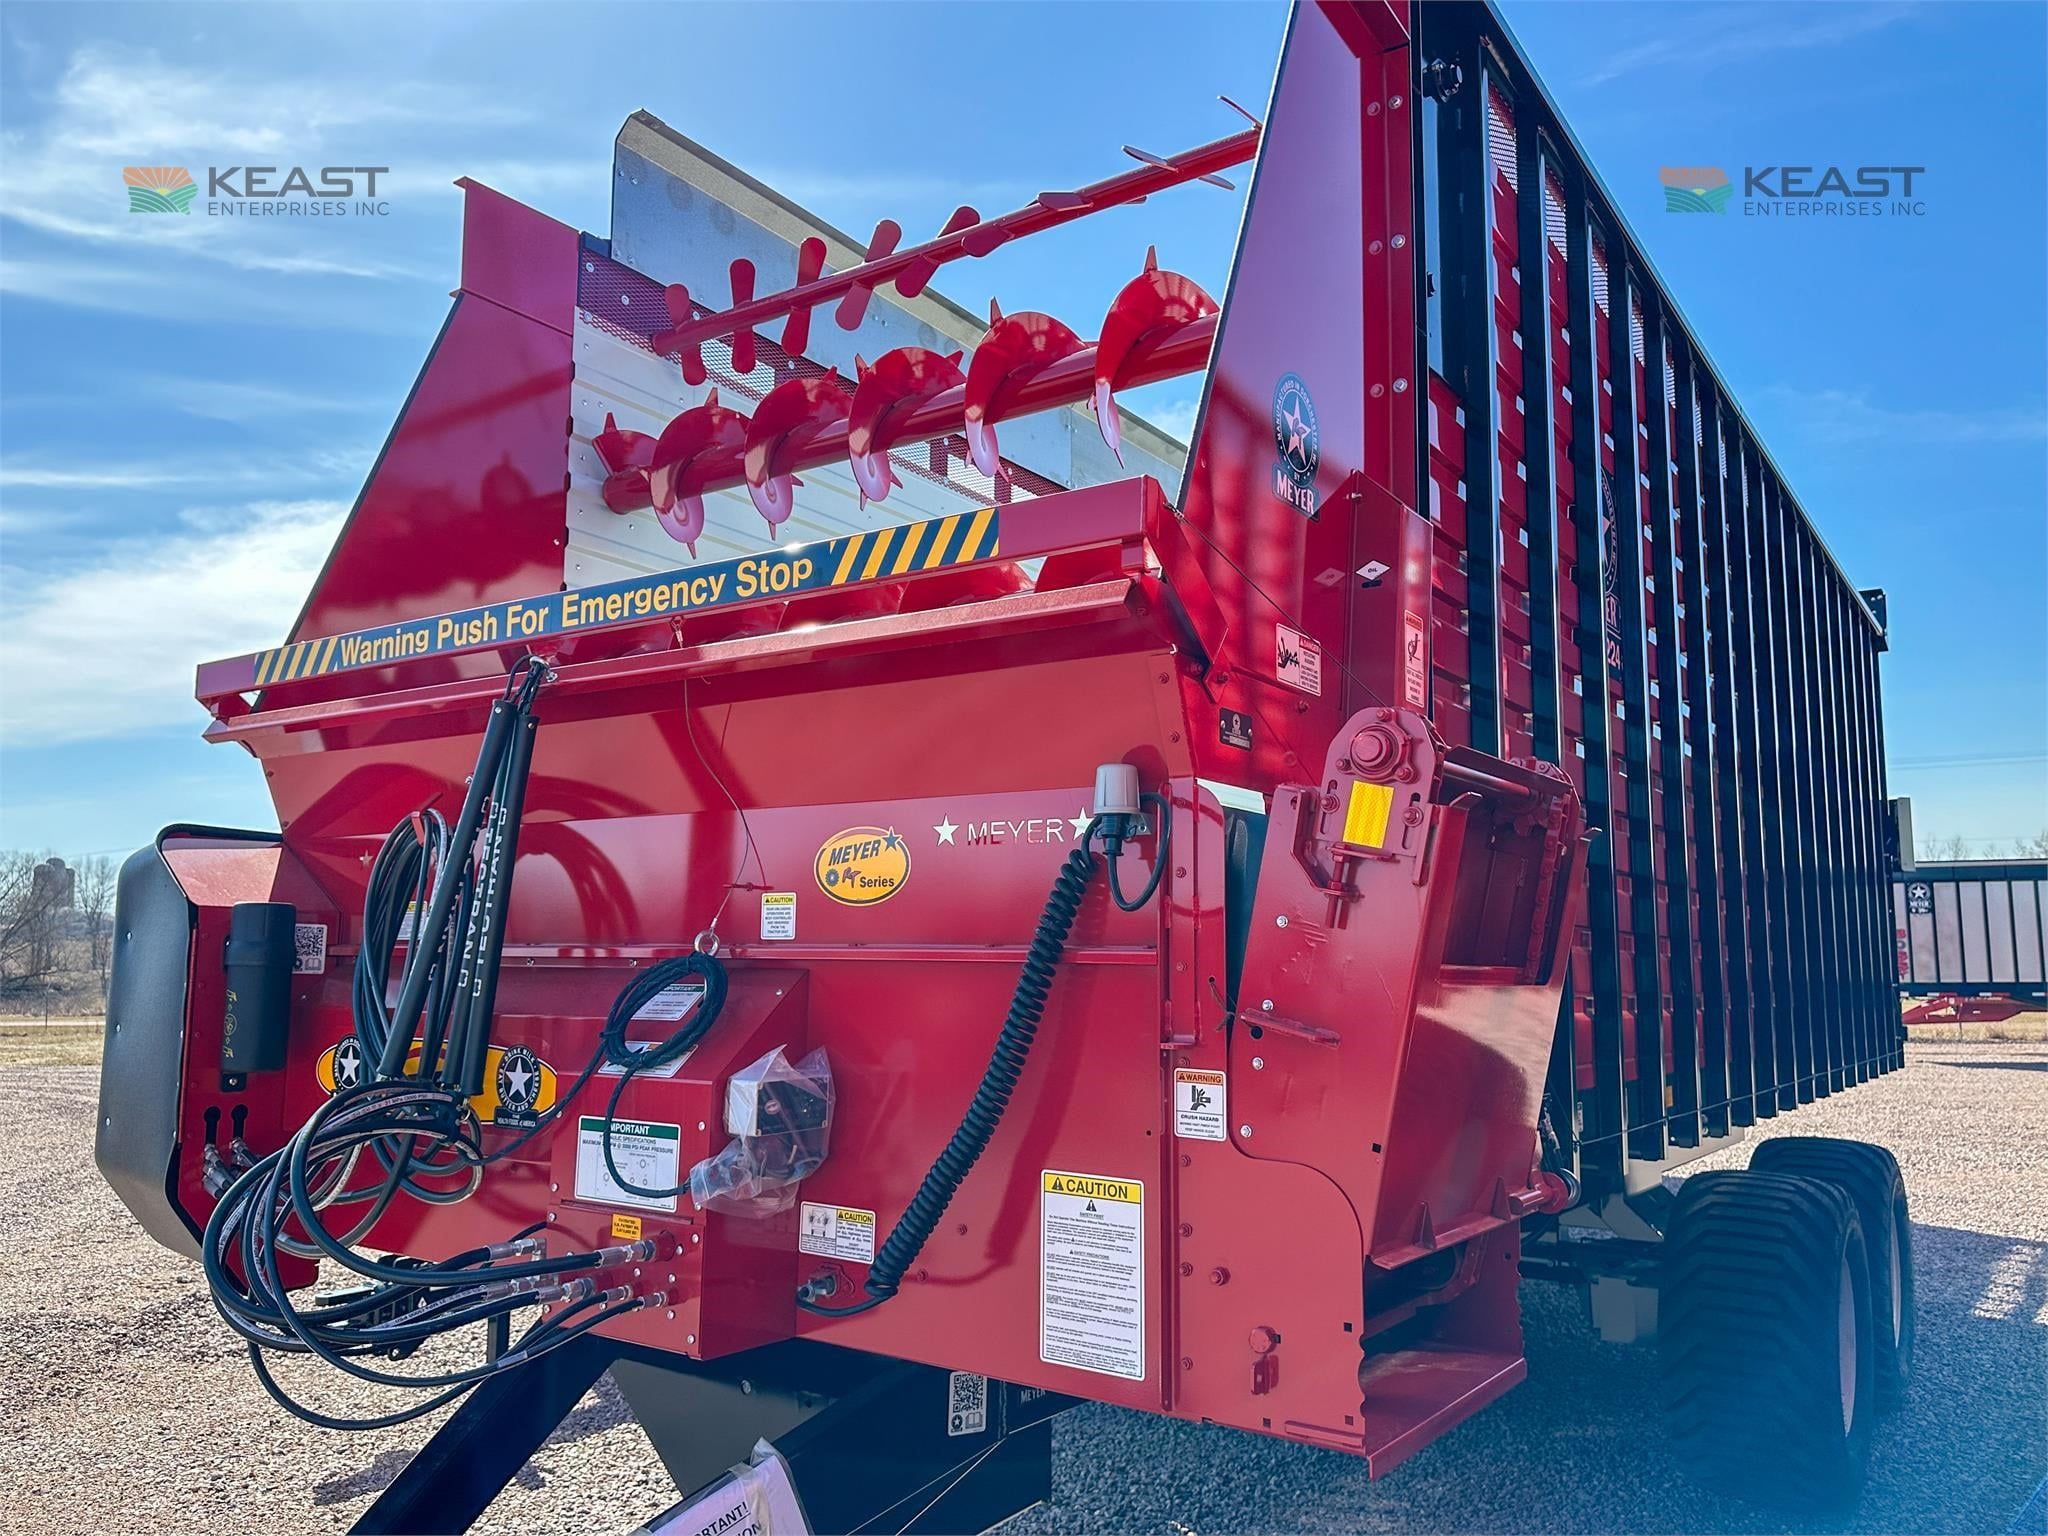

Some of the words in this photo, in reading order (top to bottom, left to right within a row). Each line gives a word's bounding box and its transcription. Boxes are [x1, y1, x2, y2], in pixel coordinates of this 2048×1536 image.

[1276, 470, 1314, 515] MEYER
[341, 628, 429, 666] Warning
[437, 612, 498, 649] Push
[506, 604, 550, 638] For
[562, 572, 726, 628] Emergency
[736, 558, 814, 598] Stop
[968, 818, 1064, 846] MEYER
[828, 840, 880, 866] MEYER
[860, 876, 894, 888] Series
[505, 1048, 521, 1061] DRINK
[523, 1049, 535, 1063] MILK
[1186, 1073, 1221, 1083] WARNING
[499, 1088, 515, 1111] BUTTER
[517, 1102, 528, 1112] AND
[529, 1071, 539, 1103] CHEESE
[610, 1123, 650, 1135] MPORTANT
[623, 1136, 656, 1144] SPECIFICATIONS
[1066, 1179, 1128, 1199] CAUTION
[844, 1212, 872, 1222] CAUTION
[694, 1501, 749, 1536] RTANT!
[737, 1520, 761, 1536] ON
